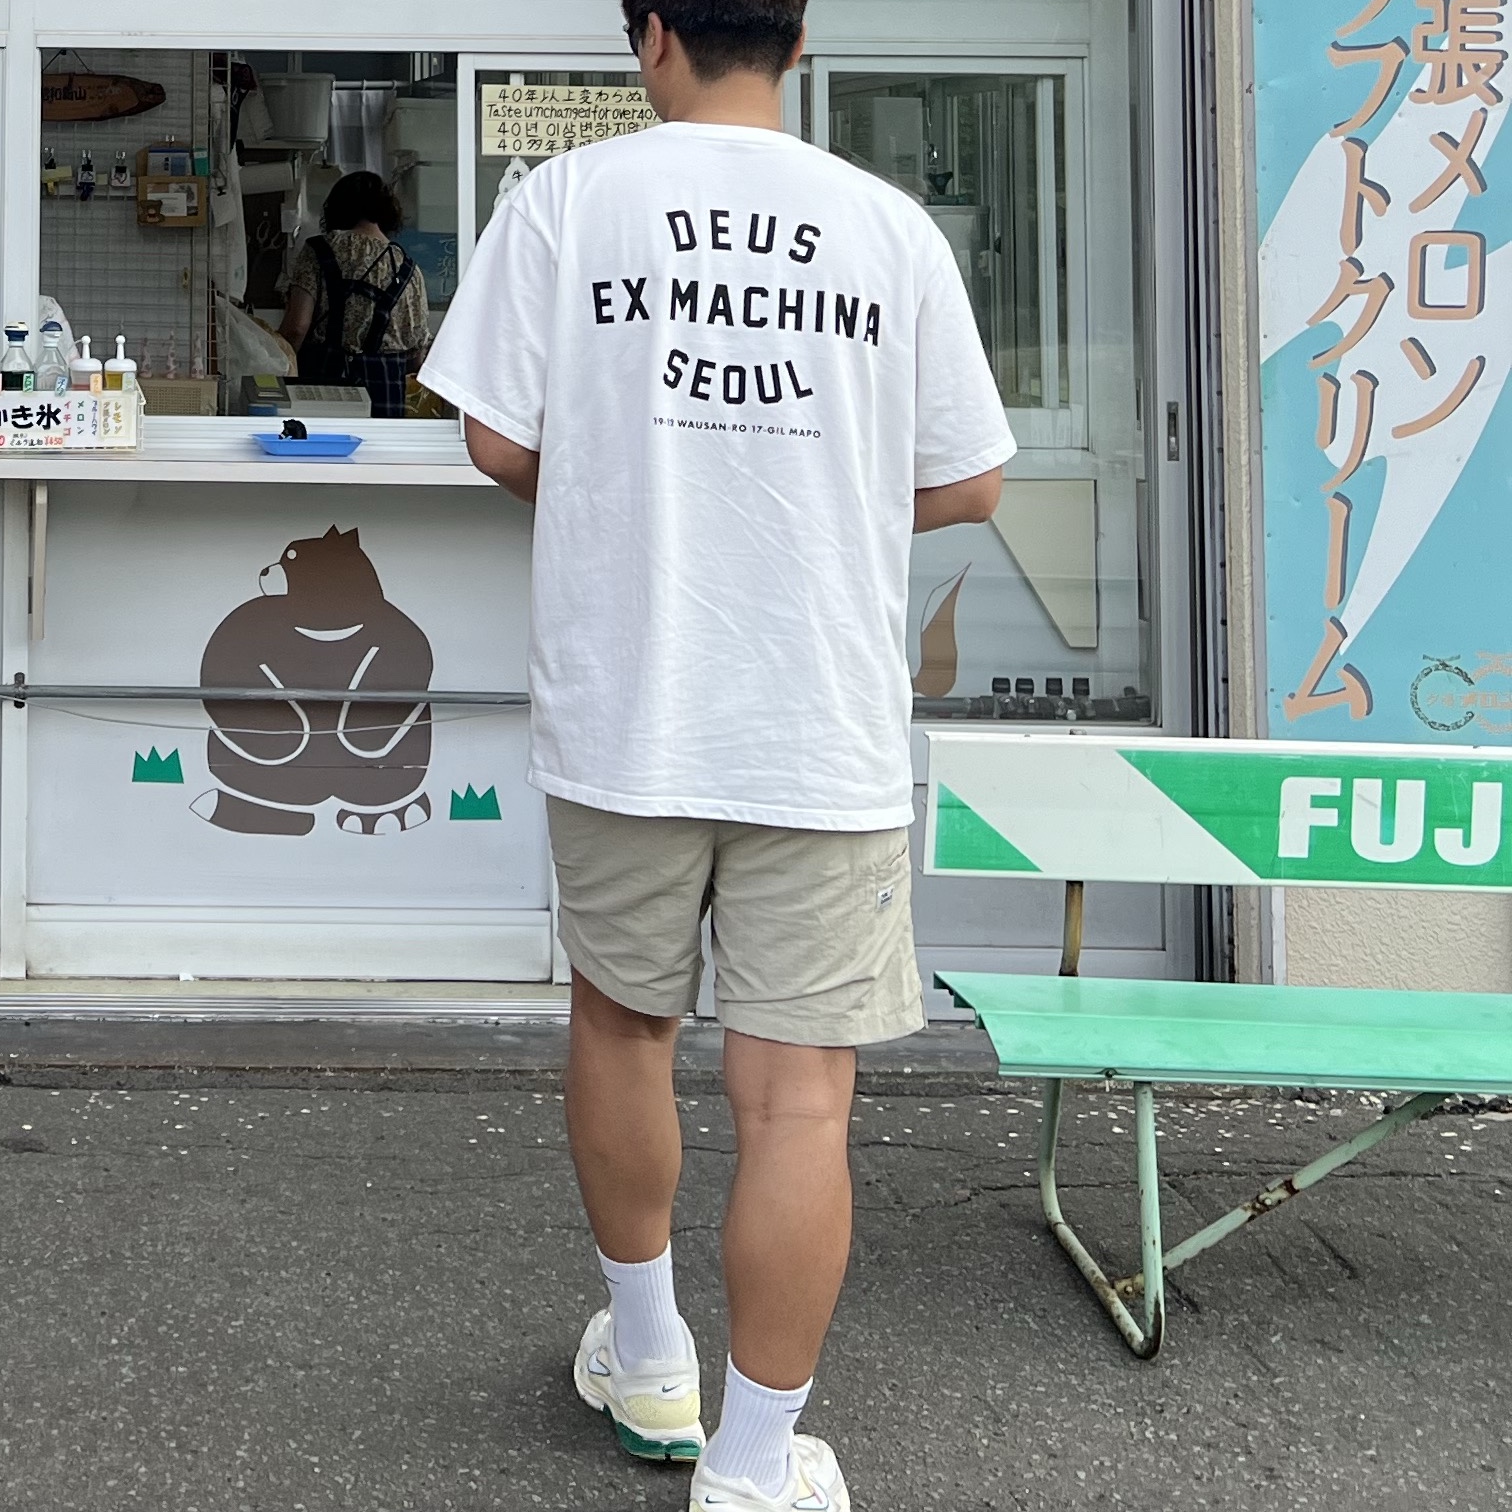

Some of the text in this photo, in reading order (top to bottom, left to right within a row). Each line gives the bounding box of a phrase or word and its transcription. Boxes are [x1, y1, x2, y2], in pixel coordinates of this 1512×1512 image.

[665, 209, 821, 264] DEUS
[592, 277, 881, 347] EX MACHINA
[663, 348, 814, 405] SEOUL
[788, 428, 821, 439] MAPO
[1277, 776, 1503, 866] FUJ
